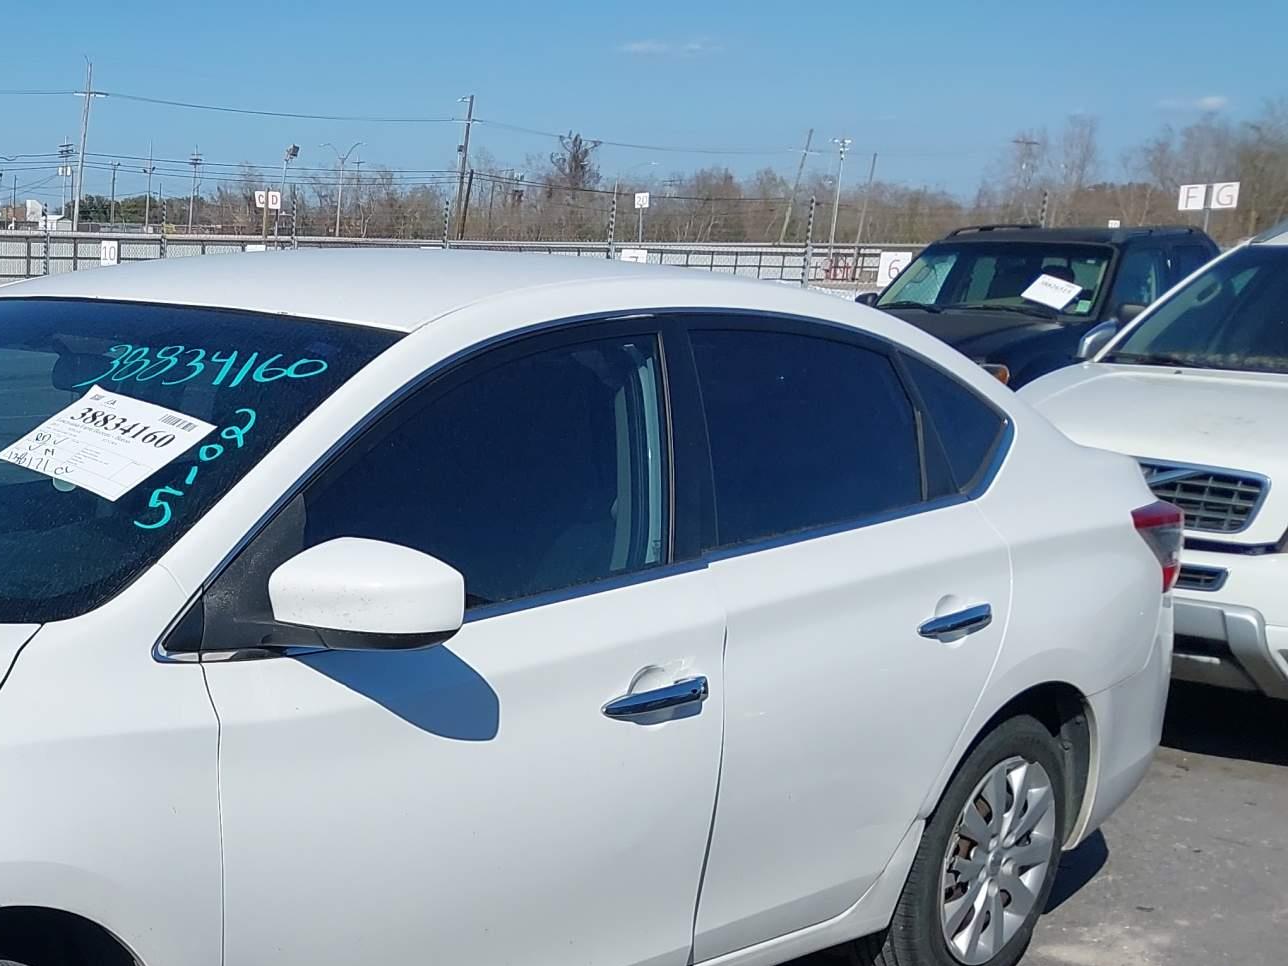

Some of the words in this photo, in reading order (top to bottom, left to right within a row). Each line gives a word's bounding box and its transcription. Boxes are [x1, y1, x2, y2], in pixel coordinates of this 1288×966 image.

[258, 194, 265, 205] C
[271, 194, 278, 205] D
[1184, 186, 1199, 208] F
[1216, 184, 1234, 206] G
[103, 246, 116, 261] 10
[888, 259, 901, 280] 6
[73, 344, 328, 388] 38834160
[70, 406, 177, 448] 38834160
